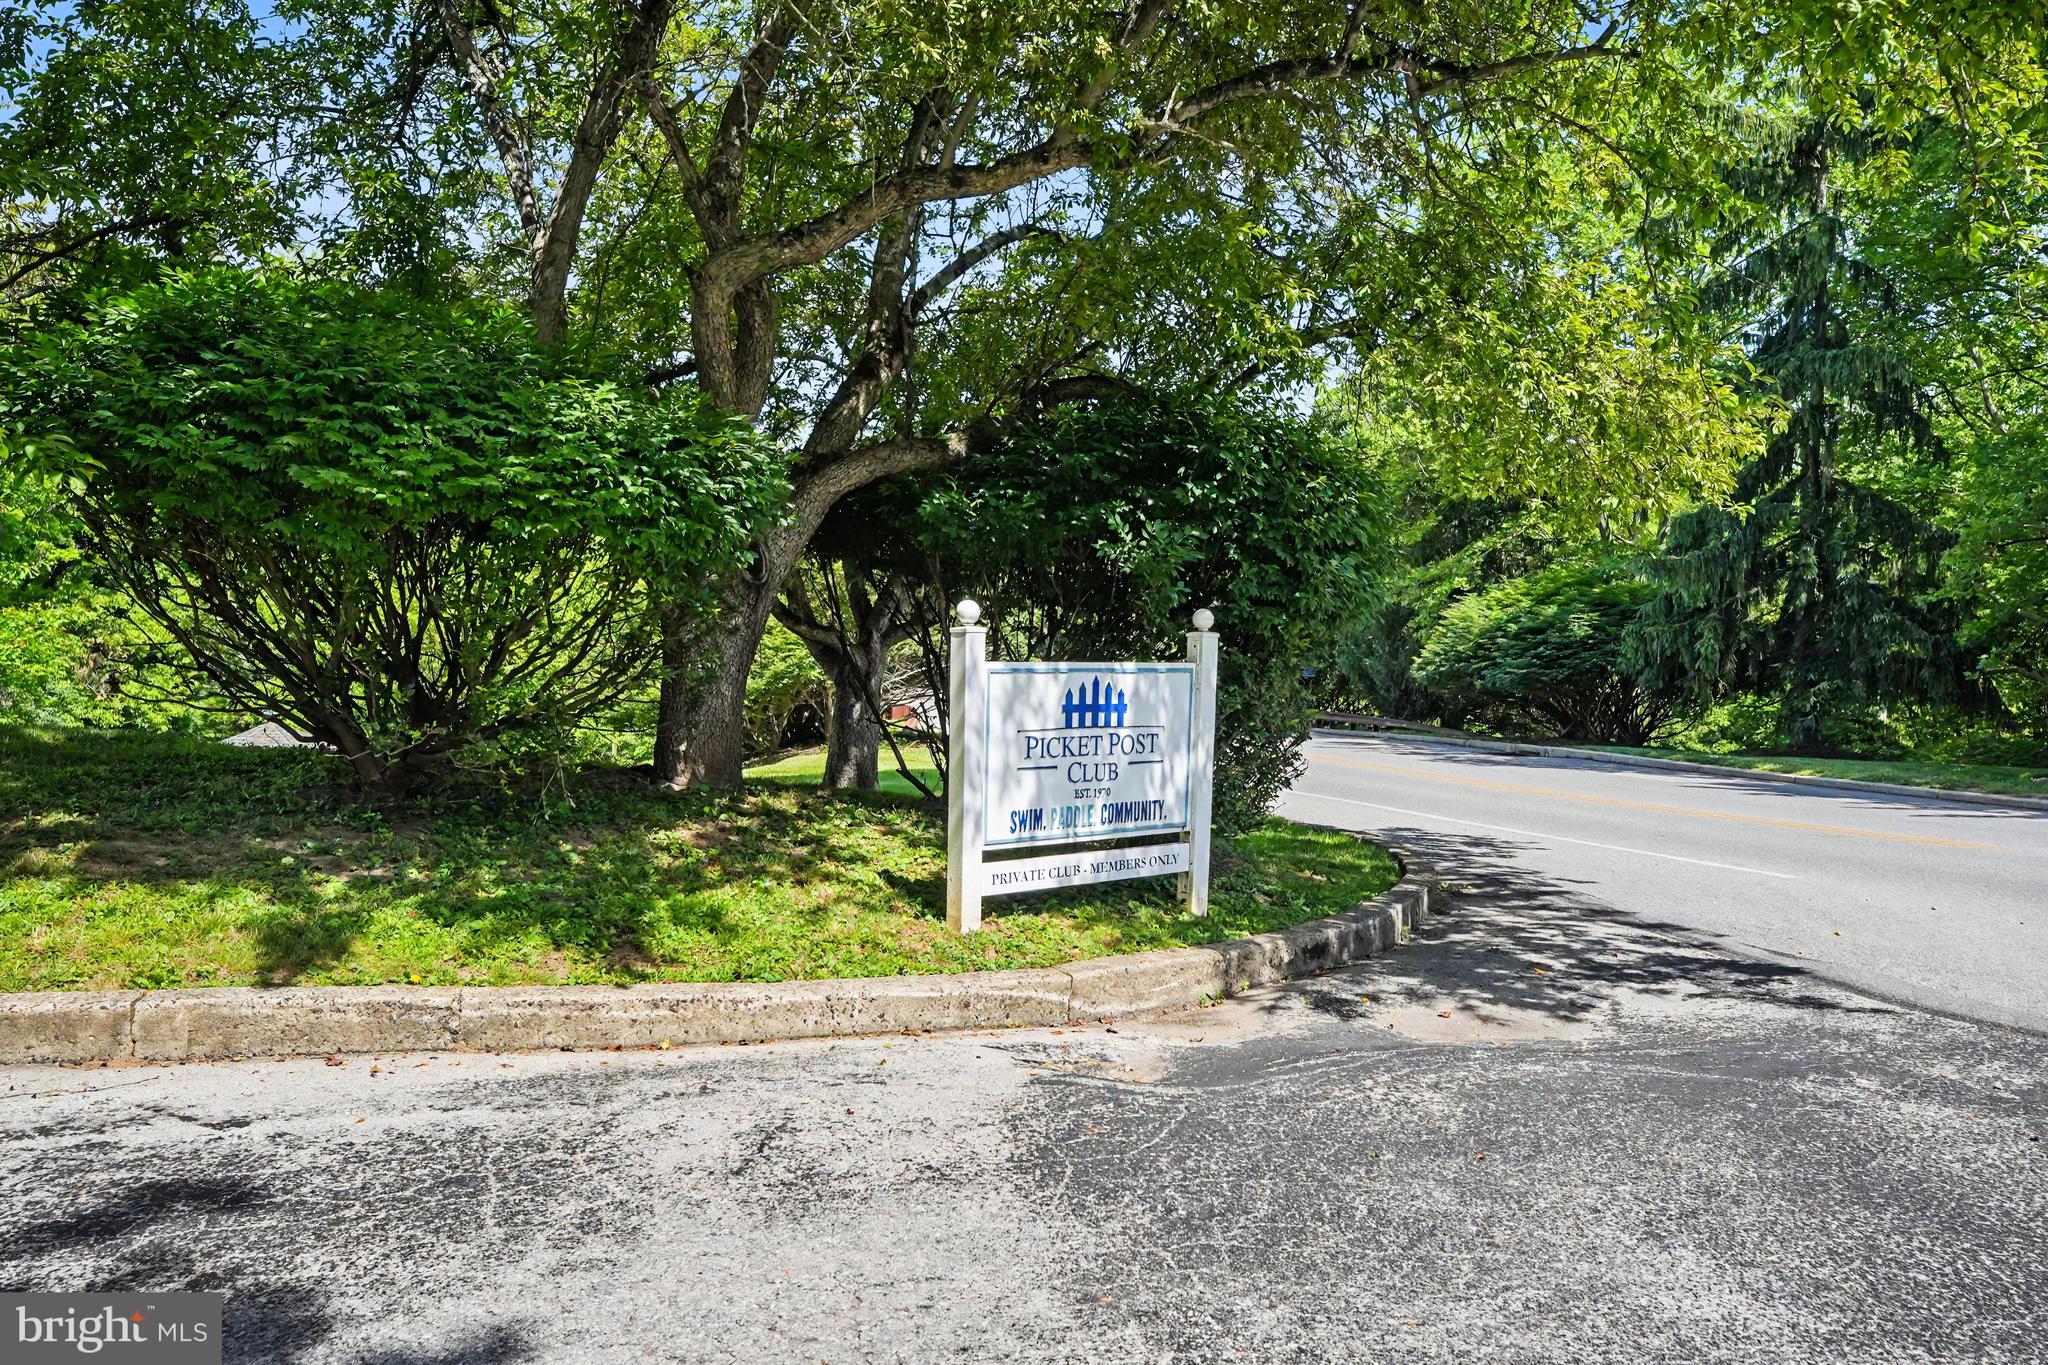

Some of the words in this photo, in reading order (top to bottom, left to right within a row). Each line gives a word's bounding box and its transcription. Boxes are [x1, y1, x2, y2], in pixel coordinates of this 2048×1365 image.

[1024, 735, 1103, 760] PICKET
[1108, 733, 1159, 755] POST
[1067, 762, 1119, 784] CLUB
[1074, 788, 1092, 799] EST.
[1009, 808, 1047, 834] SWIM.
[1100, 800, 1167, 827] COMMUNITY.
[991, 868, 1046, 886] PRIVATE
[1048, 864, 1081, 879] CLUB
[1090, 858, 1147, 874] MEMBERS
[1149, 853, 1180, 867] ONLY
